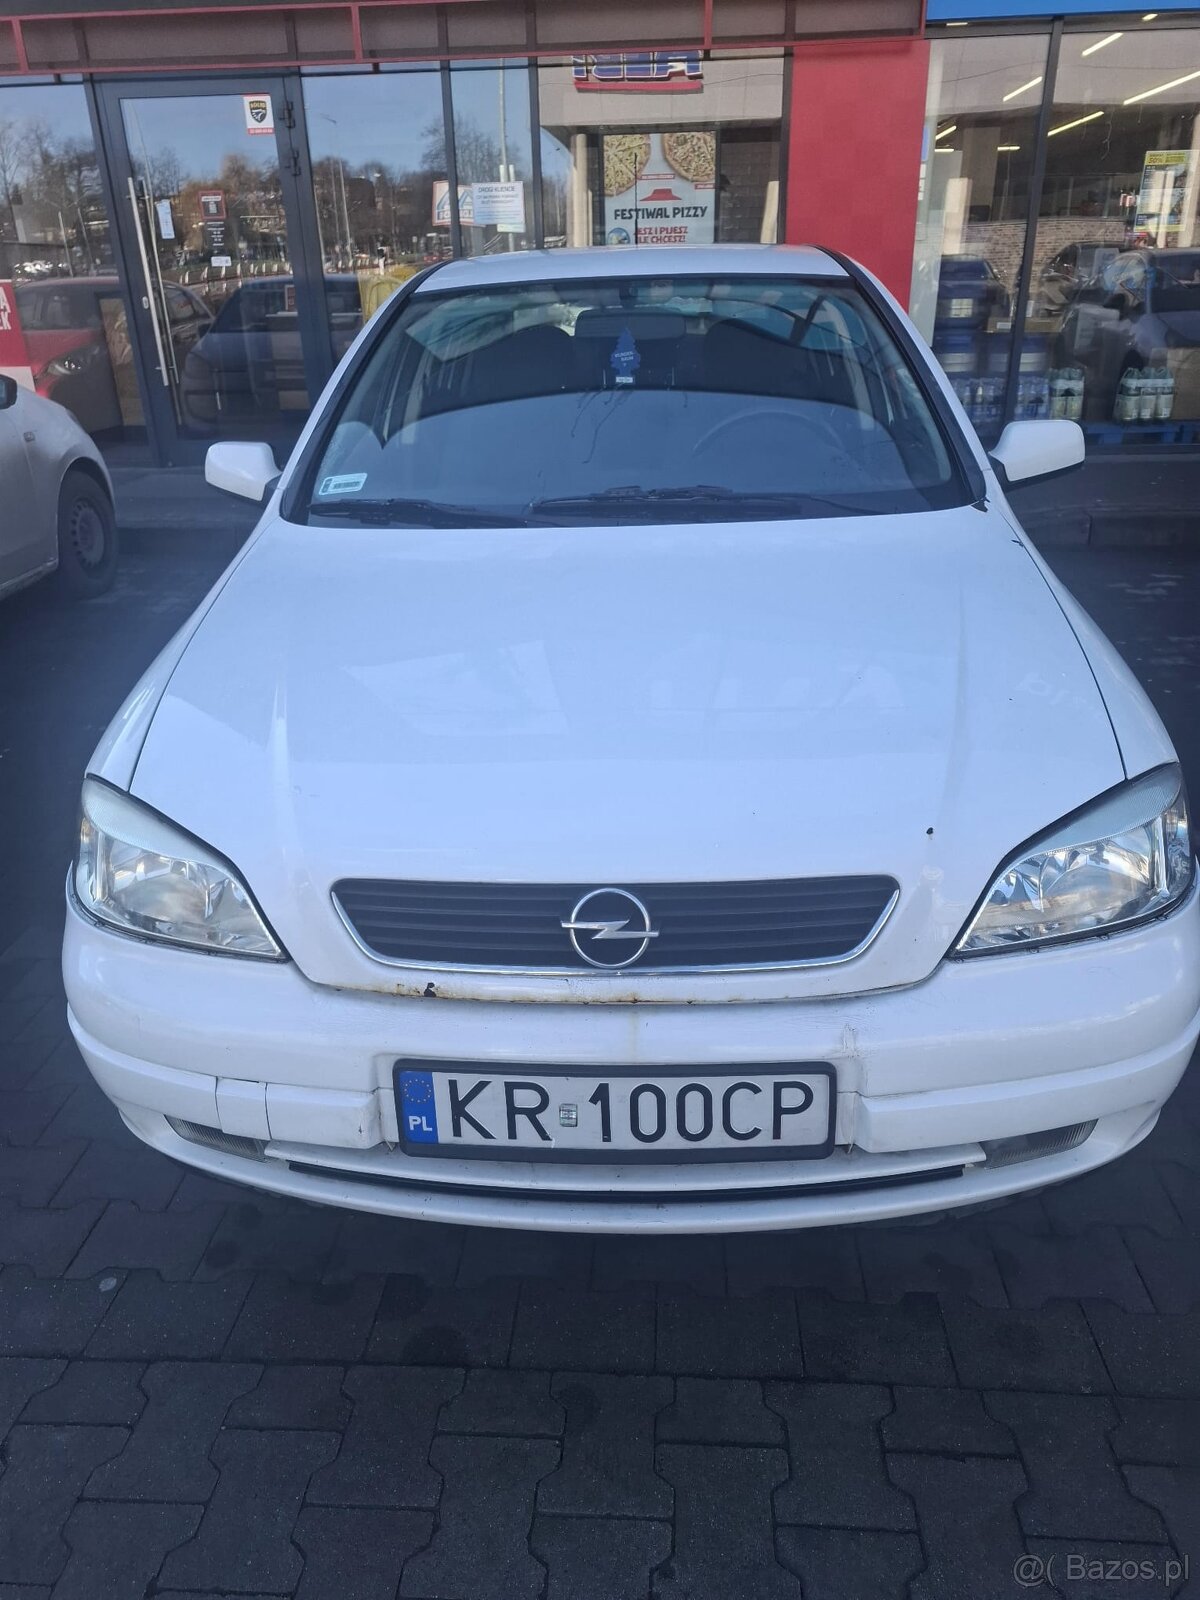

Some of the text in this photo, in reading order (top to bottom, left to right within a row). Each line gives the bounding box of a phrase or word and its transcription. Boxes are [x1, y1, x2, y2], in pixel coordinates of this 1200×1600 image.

[614, 205, 708, 220] FESTIWAL PIZZY
[659, 226, 688, 235] PIJESZ
[448, 1078, 814, 1143] KR 100CP
[408, 1115, 433, 1131] PL
